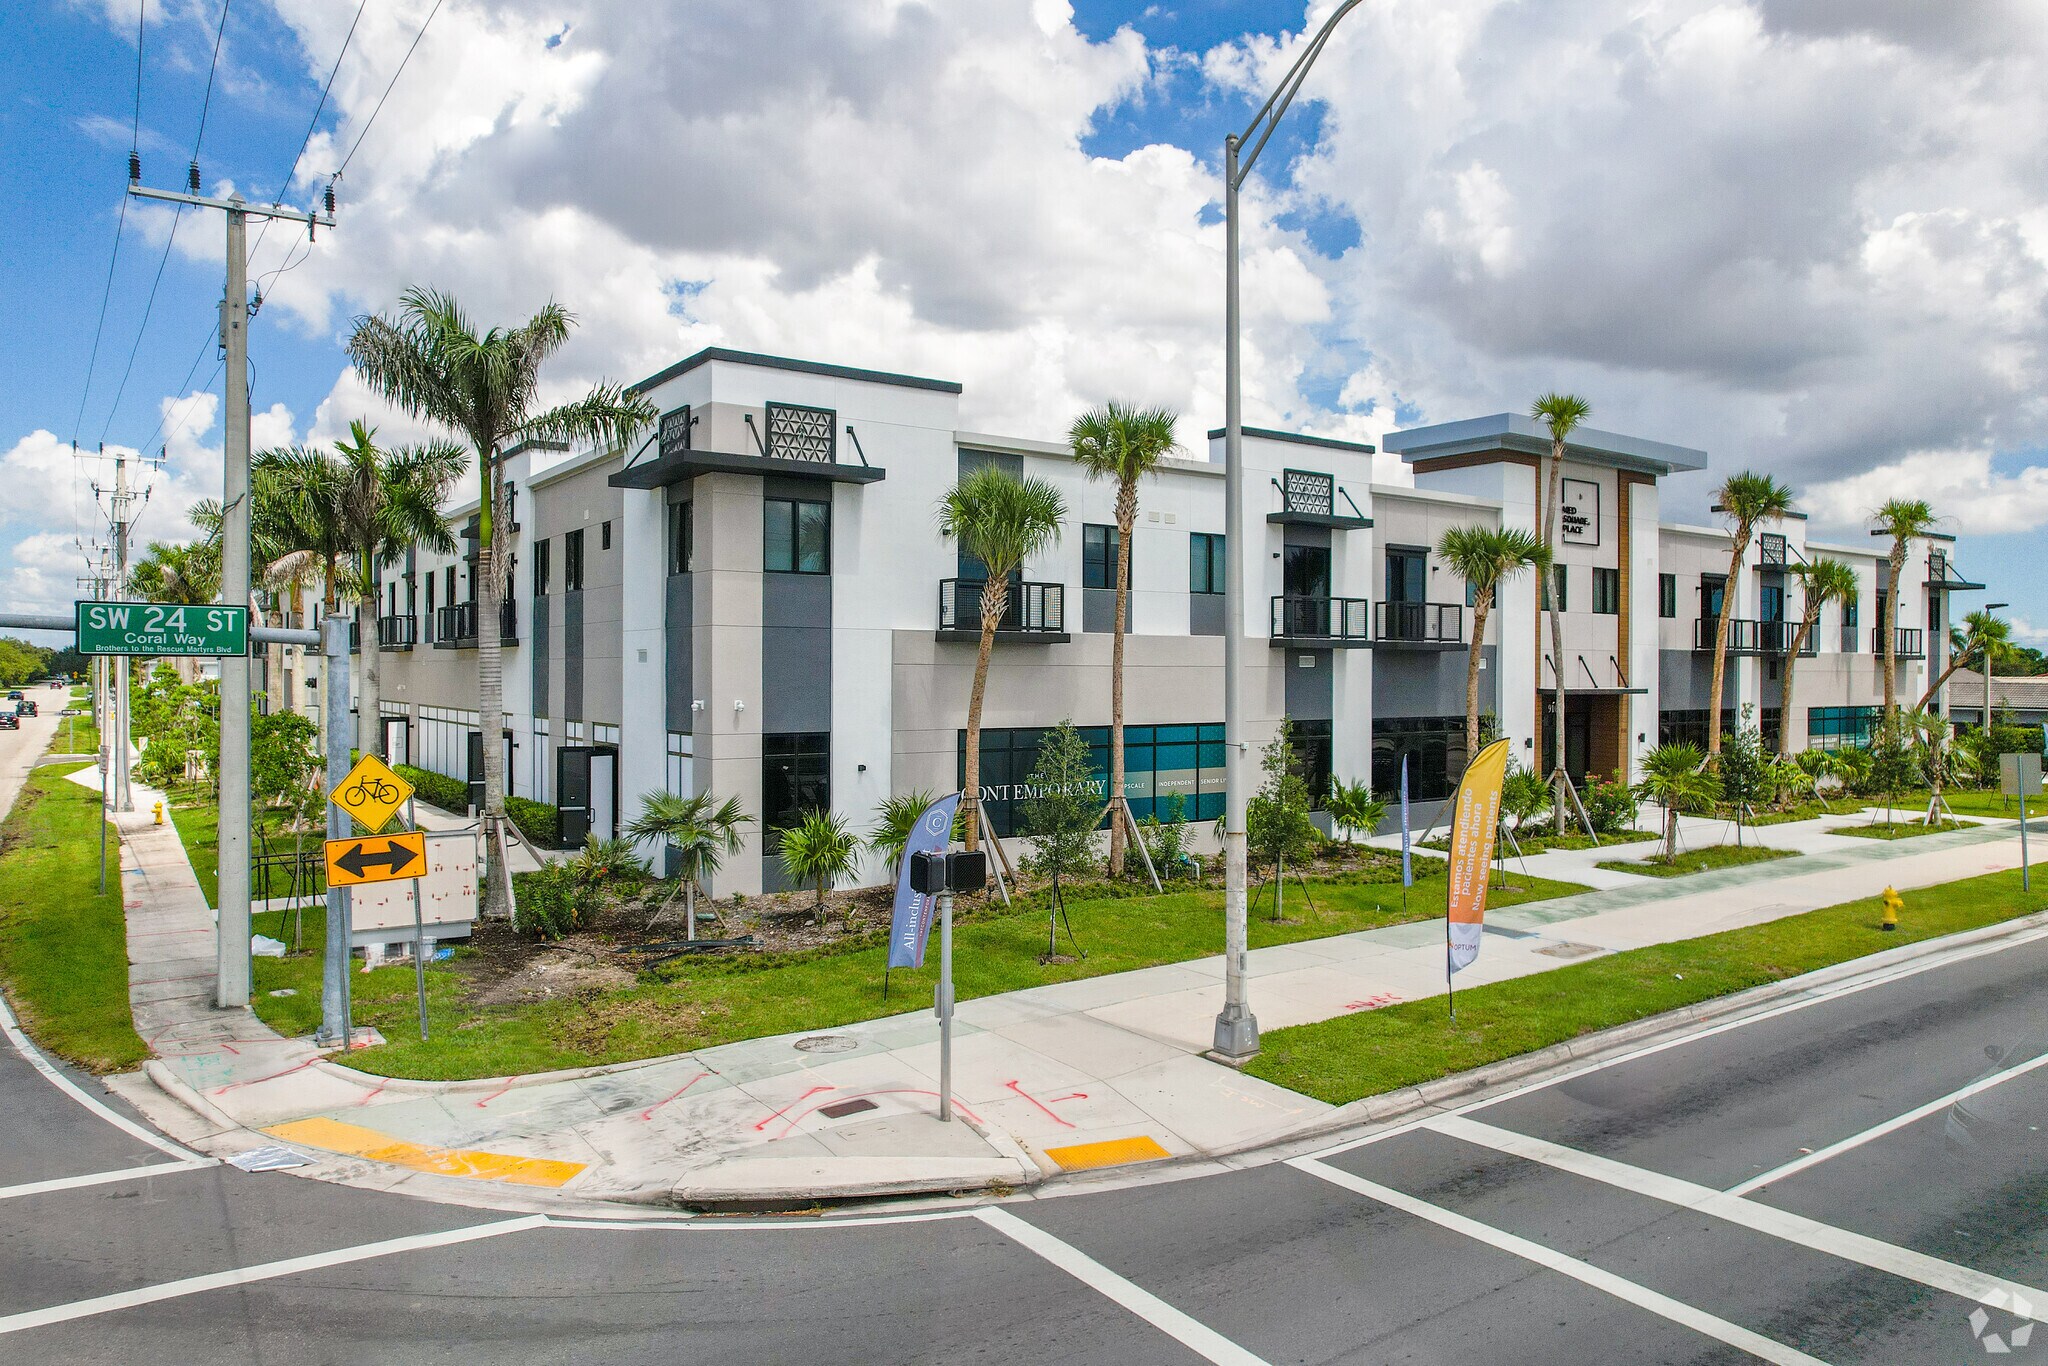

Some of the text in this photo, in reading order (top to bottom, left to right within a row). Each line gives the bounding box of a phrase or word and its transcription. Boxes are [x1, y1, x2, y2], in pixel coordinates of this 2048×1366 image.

[1562, 524, 1583, 534] PLACE
[88, 606, 238, 633] SW 24 ST
[124, 632, 206, 647] Coral Way
[95, 644, 128, 652] Brothers
[142, 645, 154, 653] the
[157, 645, 184, 653] Rescue
[186, 646, 214, 654] Martyrs
[1158, 779, 1195, 788] INDEPENDENT
[932, 817, 942, 828] C
[1450, 788, 1473, 908] Estamos atendiendo
[1462, 803, 1483, 896] pacientes ahora
[1472, 790, 1498, 911] Now seeing patients
